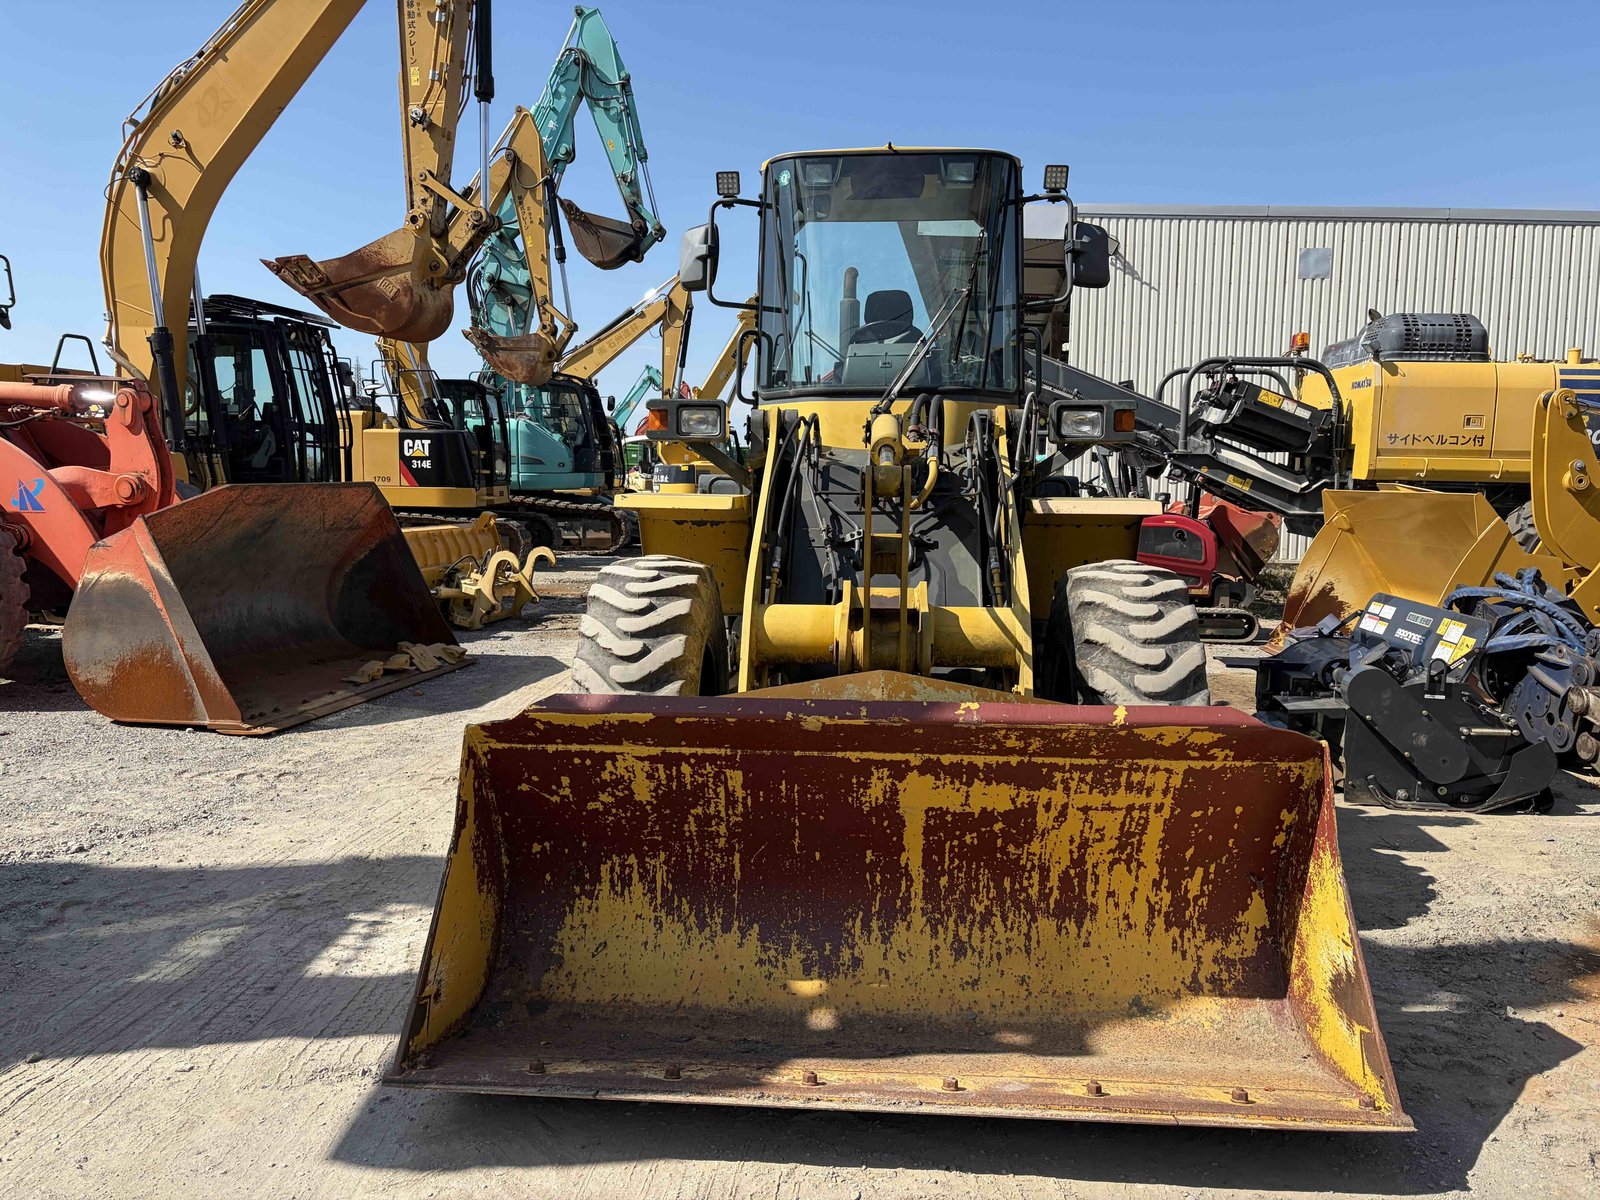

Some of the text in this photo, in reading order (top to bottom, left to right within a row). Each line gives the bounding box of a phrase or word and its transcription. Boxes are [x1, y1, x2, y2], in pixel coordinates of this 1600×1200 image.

[1387, 433, 1485, 447] サイドベルコン付
[403, 439, 431, 457] CAT
[411, 460, 432, 469] 314E
